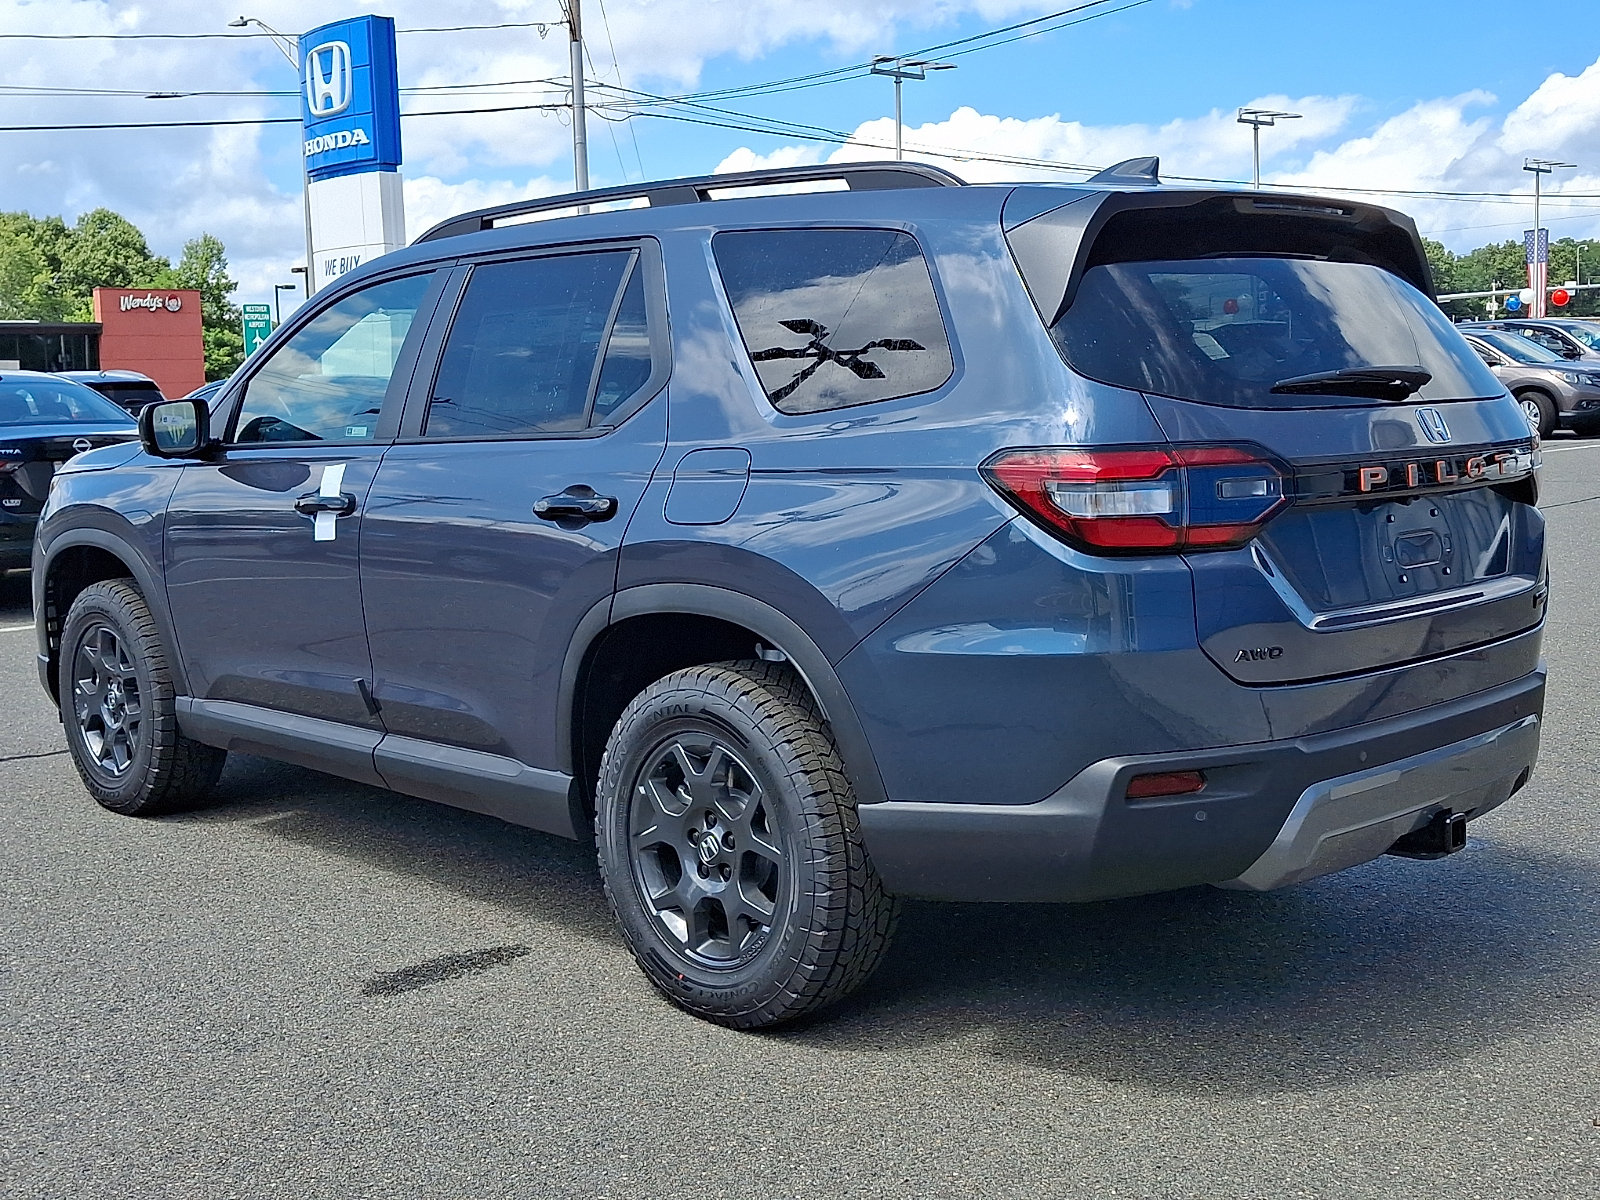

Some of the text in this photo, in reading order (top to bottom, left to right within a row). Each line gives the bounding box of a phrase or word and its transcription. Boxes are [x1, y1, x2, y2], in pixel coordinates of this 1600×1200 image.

[304, 128, 370, 157] HONDA
[325, 255, 361, 277] WE BUY
[120, 292, 163, 312] Wendy's
[1360, 453, 1510, 492] PILOT
[1234, 646, 1284, 663] AWD
